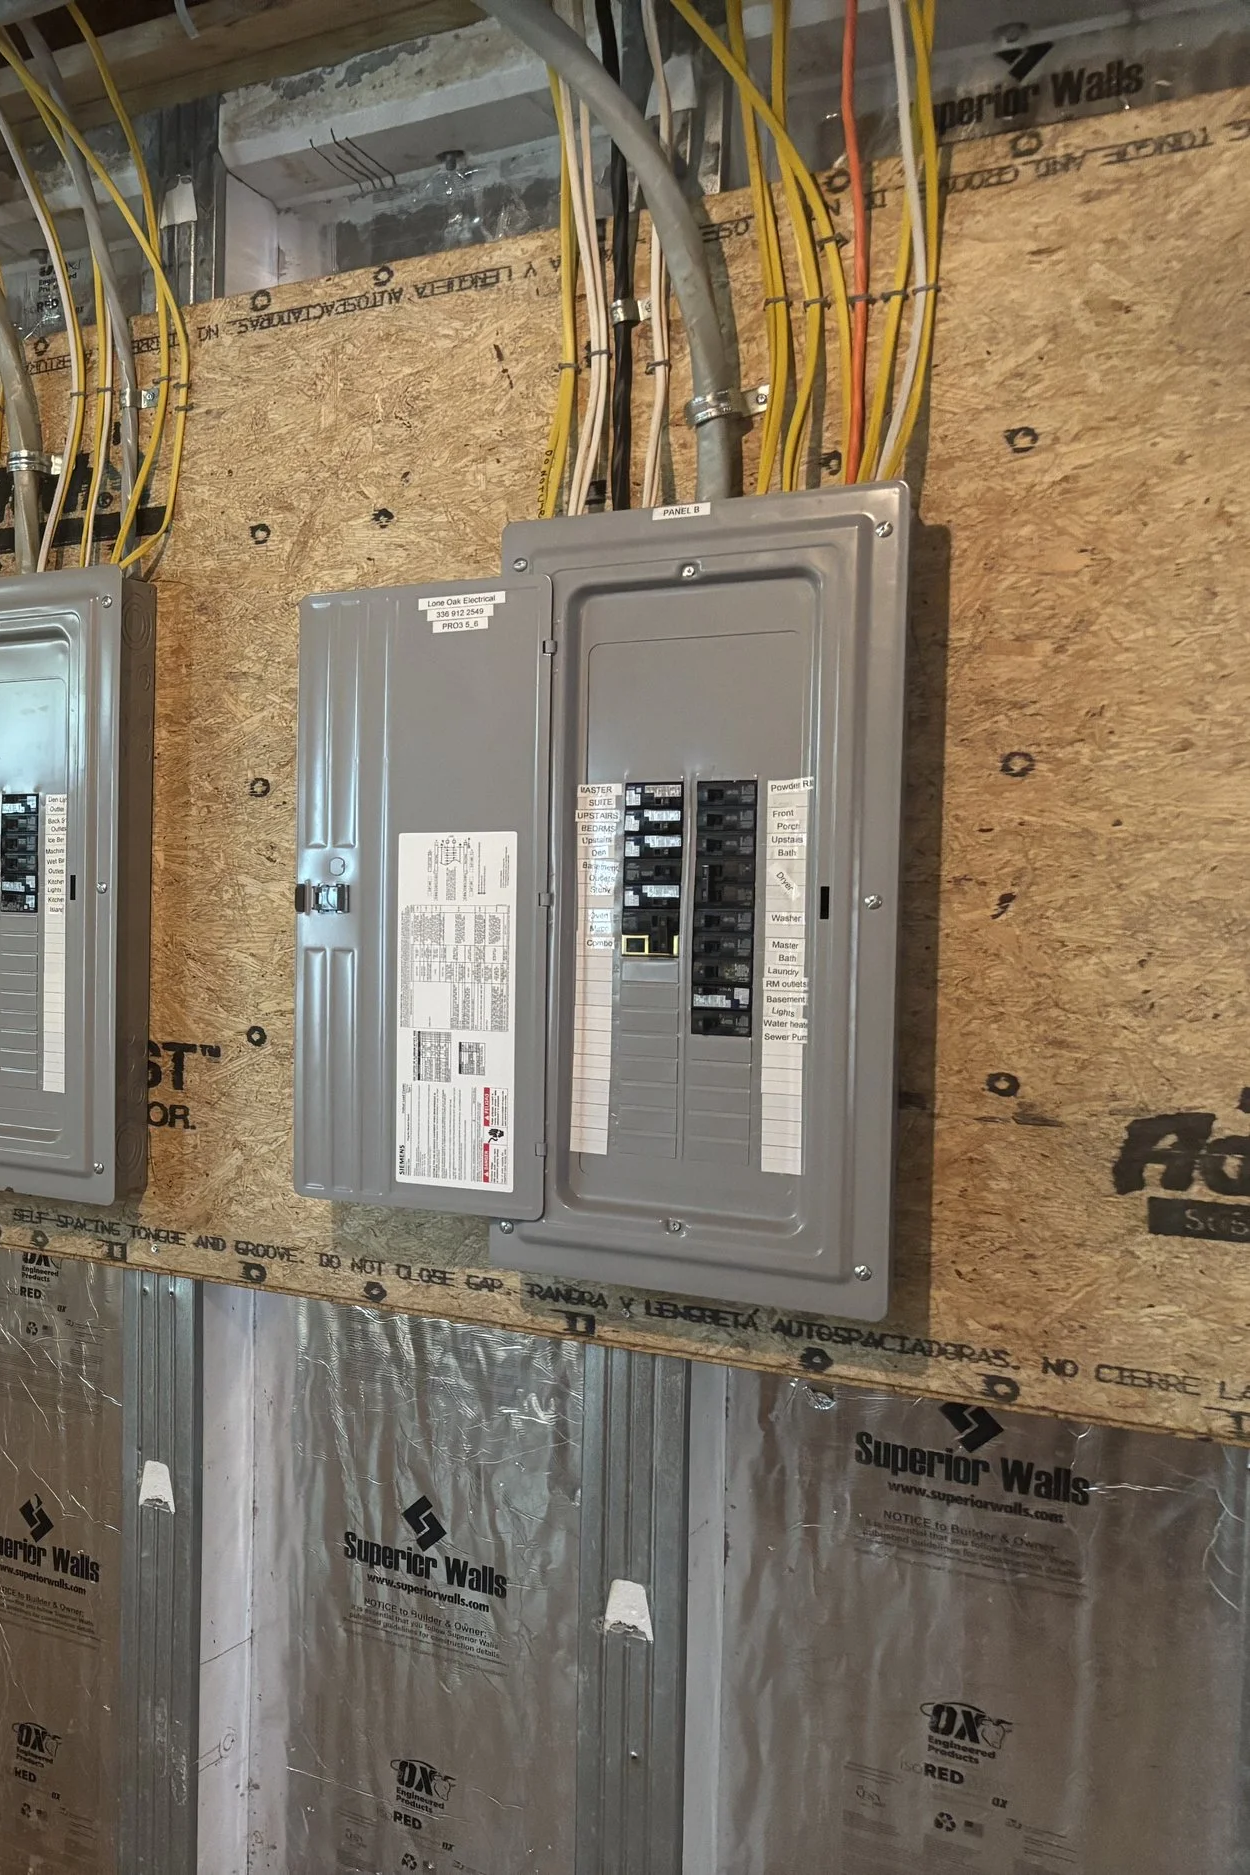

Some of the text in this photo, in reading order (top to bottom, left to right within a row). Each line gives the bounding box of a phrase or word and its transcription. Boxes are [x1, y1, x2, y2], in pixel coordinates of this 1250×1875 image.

[1051, 58, 1144, 107] Walls
[662, 505, 700, 517] PANEL B
[427, 595, 496, 608] Lone Oak Electrical
[451, 609, 464, 617] 912
[466, 608, 484, 616] 2549
[442, 620, 479, 630] PRO3 5_6
[770, 782, 801, 792] Powder
[589, 798, 613, 807] SUITE
[577, 812, 618, 820] UPSTAIRS
[772, 809, 794, 818] Front
[581, 824, 616, 833] BEDRMS
[777, 822, 801, 831] Porch
[591, 849, 607, 857] Den
[777, 848, 797, 857] Bath
[776, 871, 794, 892] Dryer
[771, 914, 802, 923] Washer
[586, 939, 613, 947] Combo
[772, 941, 799, 949] Master
[778, 954, 797, 962] Bath
[768, 967, 799, 978] Laundry
[766, 980, 807, 988] RM outlets
[766, 995, 806, 1004] Basement
[771, 1007, 795, 1018] Lights
[763, 1019, 788, 1028] Water
[764, 1033, 790, 1041] Sewer
[21, 1266, 59, 1277] Engineered
[21, 1273, 51, 1283] Products
[12, 1208, 121, 1237] SELF-SPACING
[130, 1224, 186, 1247] TONGUE
[194, 1234, 227, 1253] AND
[235, 1240, 304, 1265] GROOVE.
[315, 1252, 341, 1269] DO
[351, 1257, 385, 1276] NOT
[395, 1263, 456, 1287] CLOSE
[1042, 1356, 1079, 1378] NO
[1094, 1364, 1201, 1396] CIERRE
[855, 1431, 1090, 1506] Superior Walls
[888, 1480, 1064, 1524] www.superiorwalls.com
[883, 1509, 1009, 1544] NOTICE to Builder &
[52, 1546, 100, 1583] Walls
[444, 1555, 508, 1600] Walls
[366, 1573, 490, 1613] www.superiorwalls.com
[364, 1597, 487, 1638] NOTICE to Builder & Owner:
[364, 1607, 477, 1644] essential that you follow Superior
[383, 1620, 474, 1652] guidelines for construction
[927, 1735, 996, 1760] Engineered
[927, 1744, 980, 1764] Products
[14, 1767, 37, 1783] RED
[396, 1786, 445, 1810] Engineered
[396, 1795, 433, 1813] Products
[393, 1810, 422, 1830] RED
